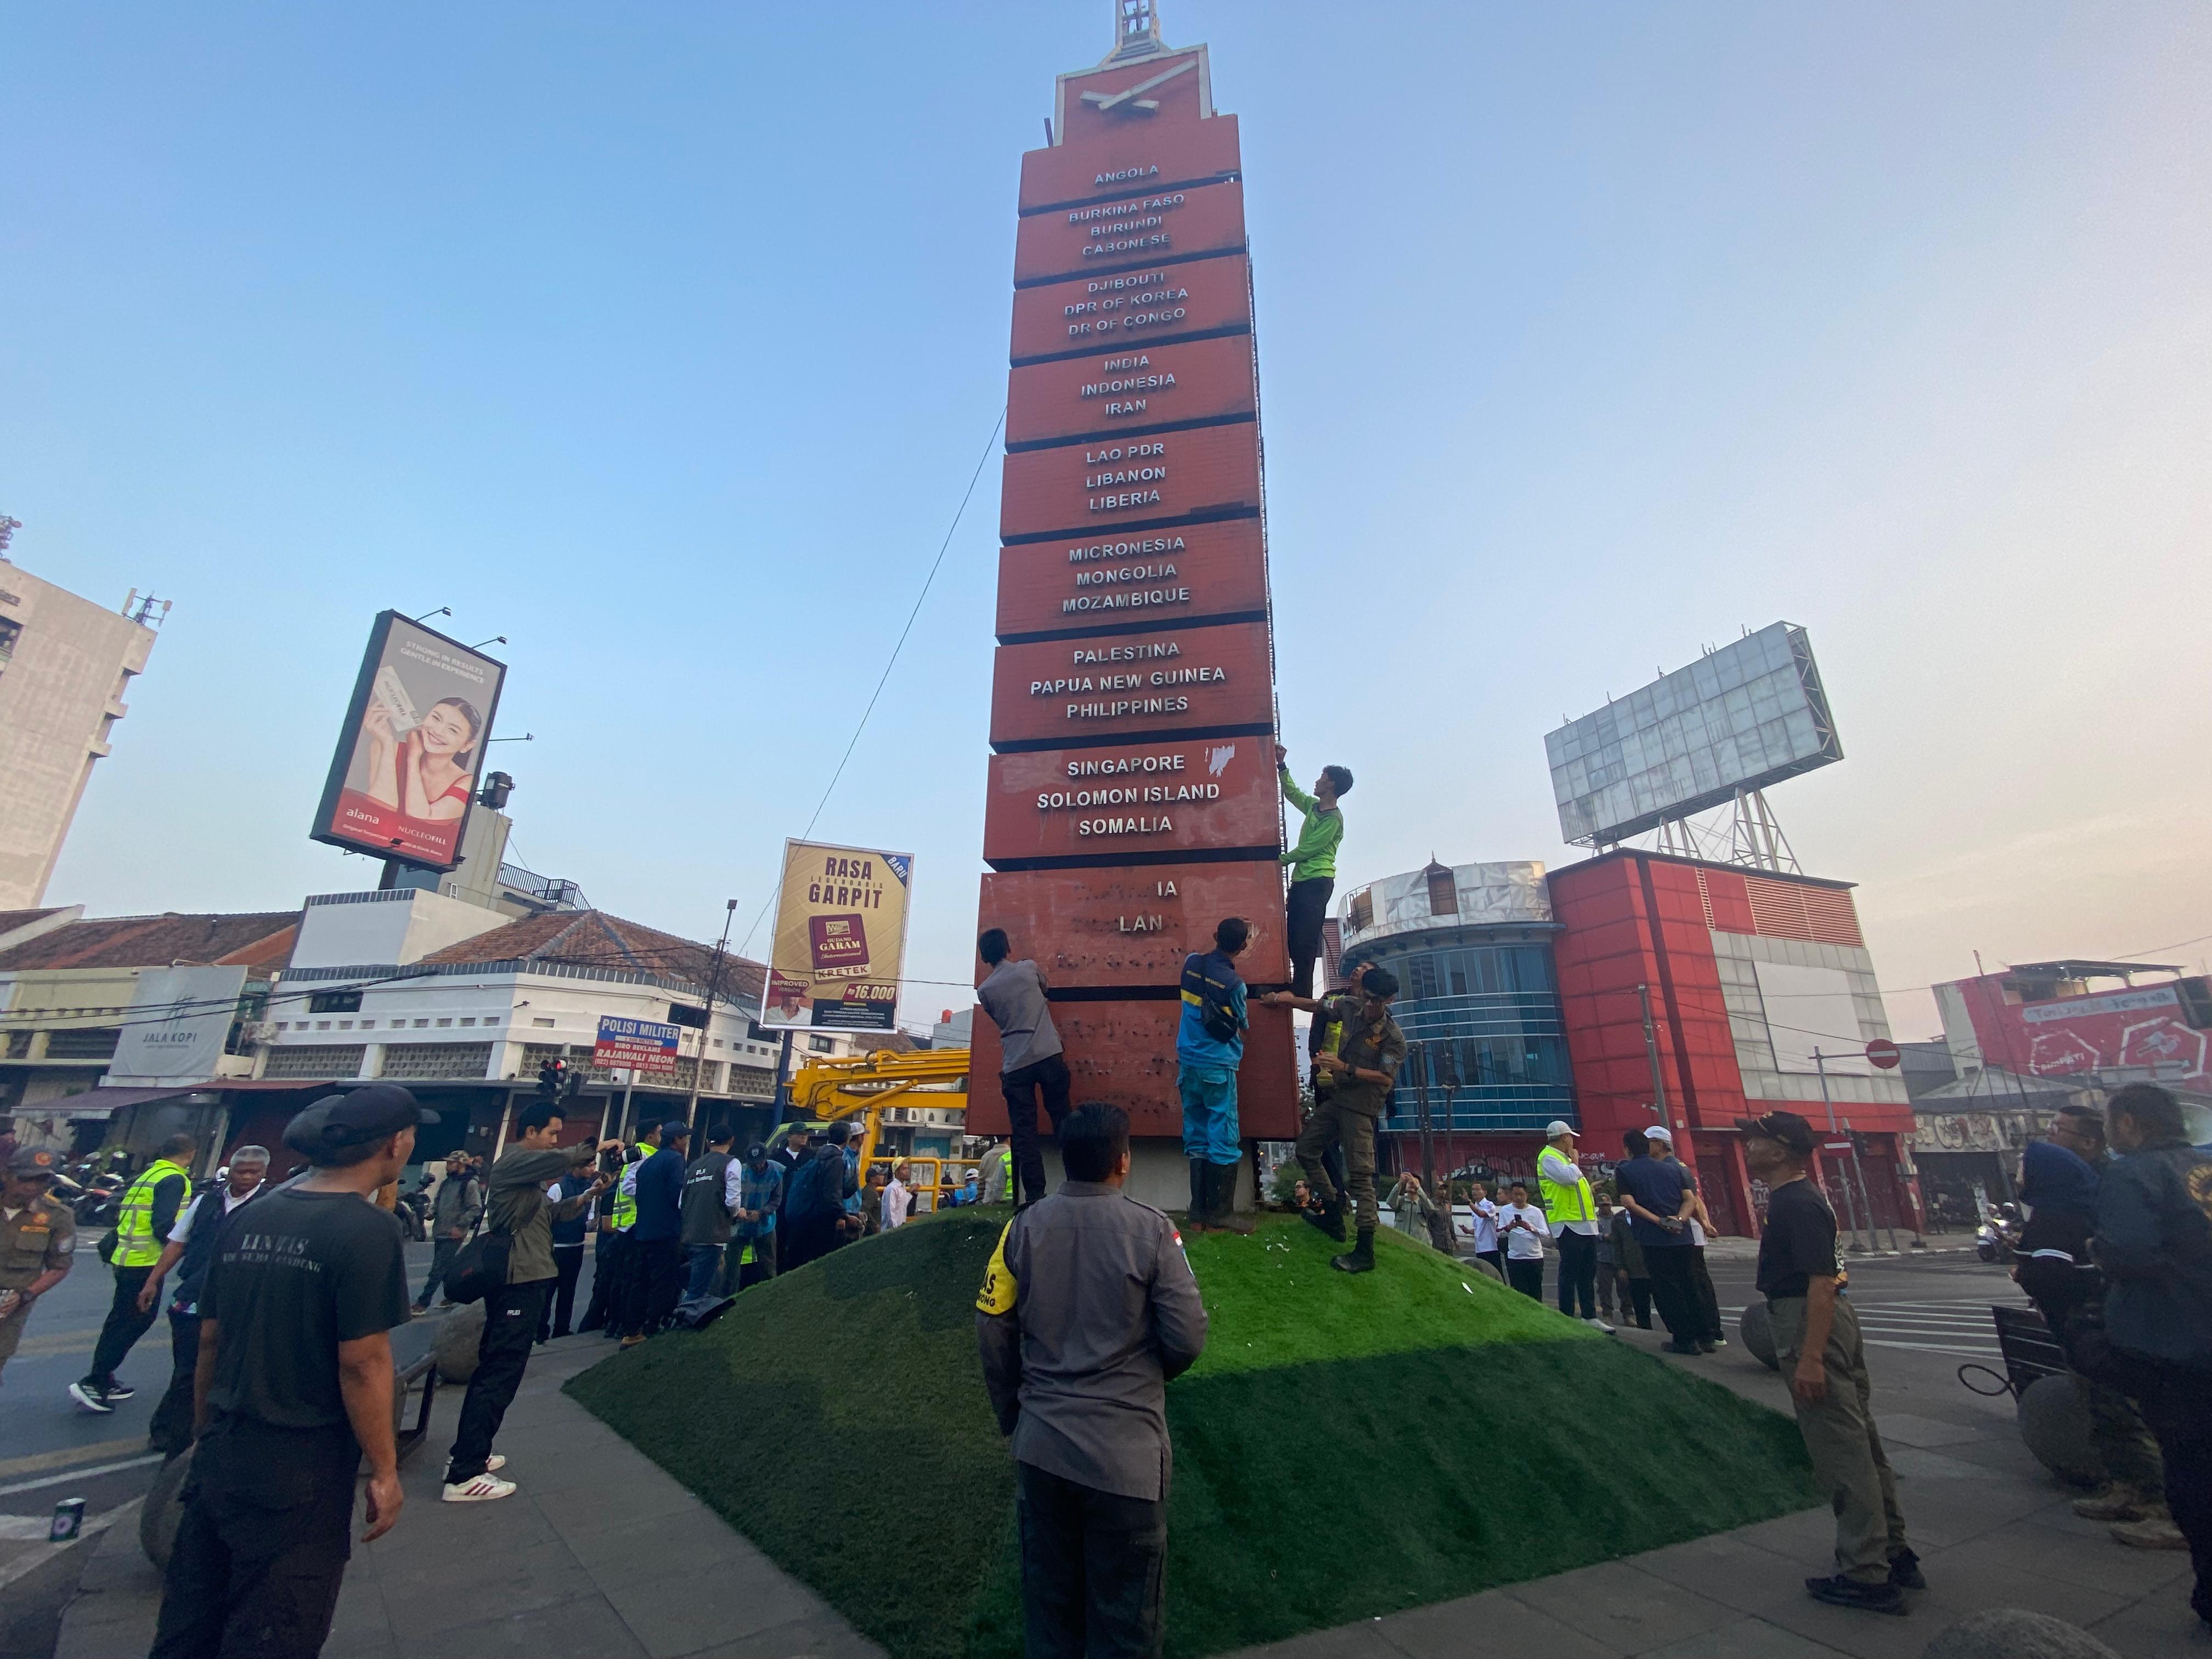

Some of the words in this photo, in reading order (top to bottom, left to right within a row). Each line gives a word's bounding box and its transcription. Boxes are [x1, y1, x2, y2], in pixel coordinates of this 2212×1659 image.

[1094, 165, 1159, 184] ANGOLA
[1069, 203, 1138, 222] BURKINA
[1143, 194, 1184, 210] FASO
[1091, 216, 1162, 236] BURUNDI
[1082, 234, 1170, 257] CABONESE
[1088, 272, 1164, 293] DJIBOUTI
[1065, 302, 1097, 316] DPR
[1103, 297, 1124, 309] OF
[1130, 288, 1188, 305] KOREA
[1069, 323, 1090, 336] DR
[1096, 318, 1118, 331] OF
[1124, 308, 1185, 327] CONGO
[1104, 355, 1149, 371] INDIA
[1081, 373, 1176, 396] INDONESIA
[1105, 399, 1146, 415] IRAN
[1086, 448, 1121, 464] LAO
[1128, 443, 1164, 458] PDR
[1086, 466, 1166, 488] LIBANON
[1089, 489, 1160, 510] LIBERIA
[1069, 537, 1185, 562] MICRONESIA
[1076, 563, 1177, 586] MONGOLIA
[1062, 587, 1190, 612] MOZAMBIQUE
[407, 641, 439, 658] STRONG
[452, 657, 483, 675] RESULTS
[1074, 642, 1181, 664] PALESTINA
[400, 648, 431, 663] GENTLE
[441, 663, 485, 684] EXPERIENCE
[1030, 678, 1093, 695] PAPUA
[1100, 674, 1142, 690] NEW
[1150, 667, 1225, 686] GUINEA
[1066, 696, 1188, 718] PHILIPPINES
[1067, 755, 1185, 777] SINGAPORE
[1036, 787, 1137, 809] SOLOMON
[1143, 783, 1220, 803] ISLAND
[347, 808, 380, 825] alana
[1079, 816, 1173, 836] SOMALIA
[398, 826, 447, 845] NUCLEOFILL
[825, 856, 872, 880] RASA
[887, 856, 908, 878] BARU
[809, 883, 882, 909] GARPIT
[1157, 881, 1178, 897] IA
[1119, 915, 1163, 932] LAN
[819, 940, 861, 951] GARAM
[818, 966, 868, 978] KRETEK
[143, 1033, 167, 1042] JALA
[171, 1032, 197, 1042] KOPI
[601, 1018, 637, 1034] POLISI
[639, 1024, 679, 1040] MILITER
[596, 1048, 646, 1062] RAJAWALI
[648, 1054, 675, 1064] NEON
[632, 1044, 661, 1053] REKLAME
